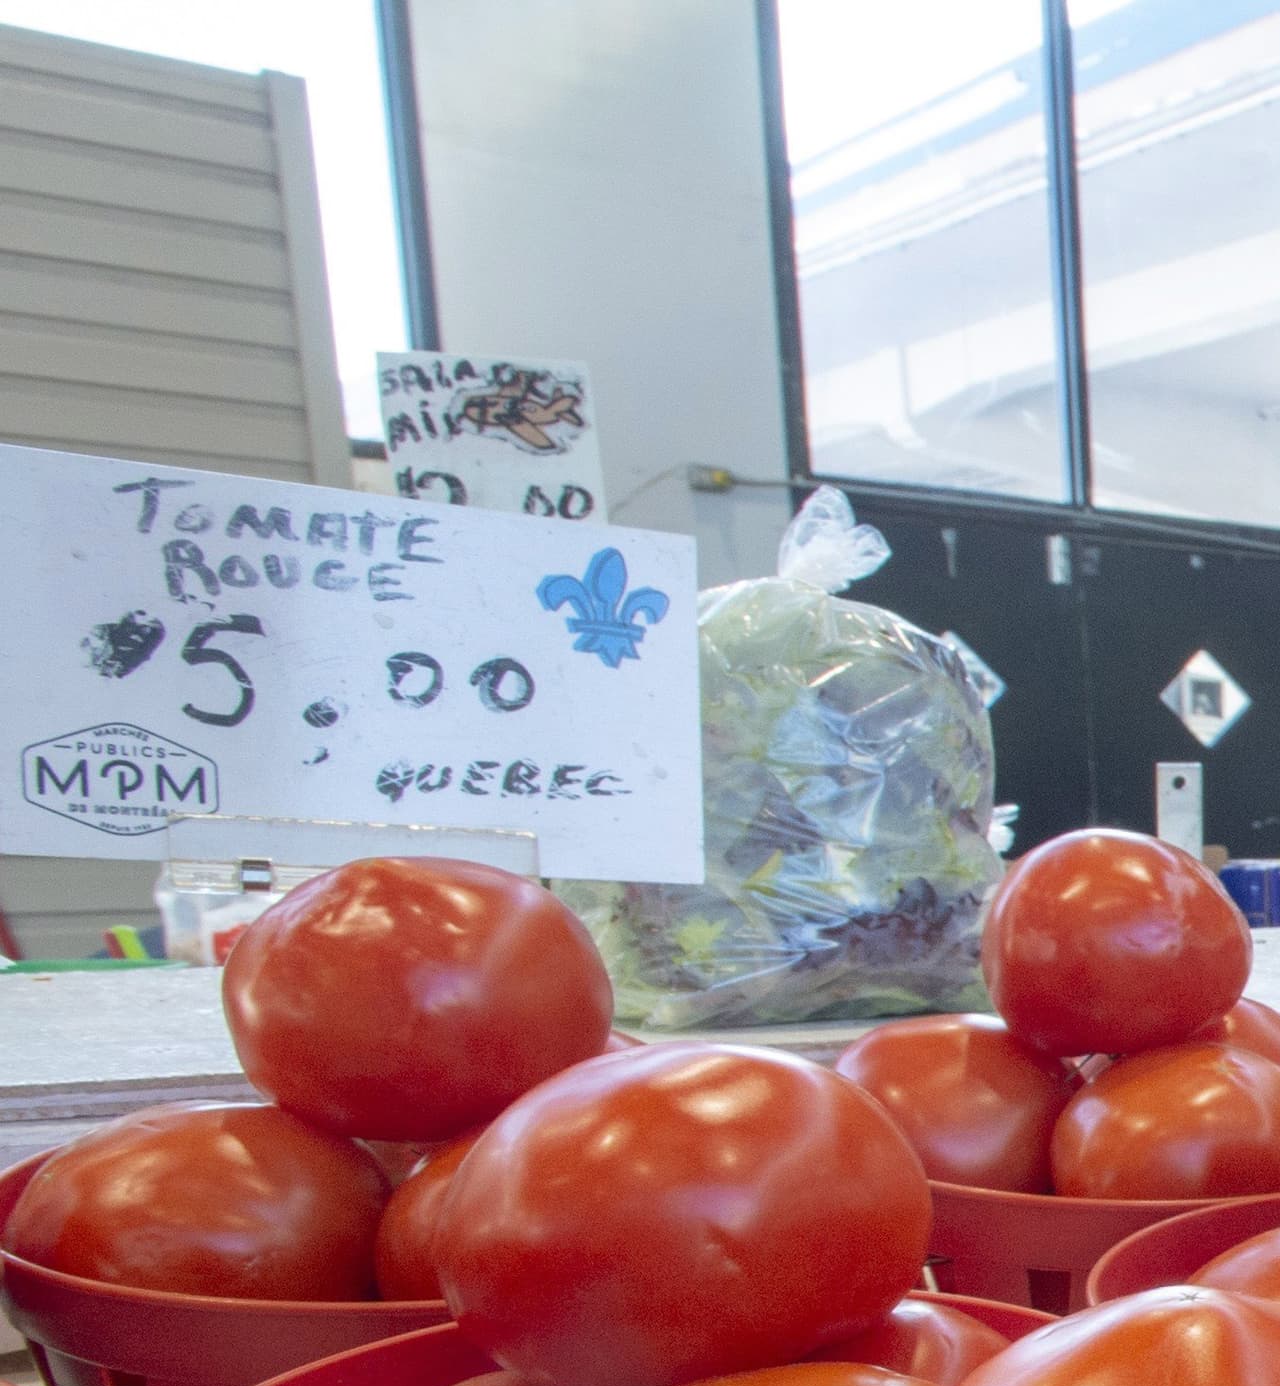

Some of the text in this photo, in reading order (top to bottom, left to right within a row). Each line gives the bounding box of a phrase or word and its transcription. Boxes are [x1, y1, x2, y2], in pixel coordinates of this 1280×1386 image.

[113, 477, 444, 563] TOMATE
[162, 538, 416, 602] ROUGE
[77, 741, 166, 759] PUBLICS
[36, 756, 206, 804] MPM
[93, 804, 175, 818] MONTRÉA
